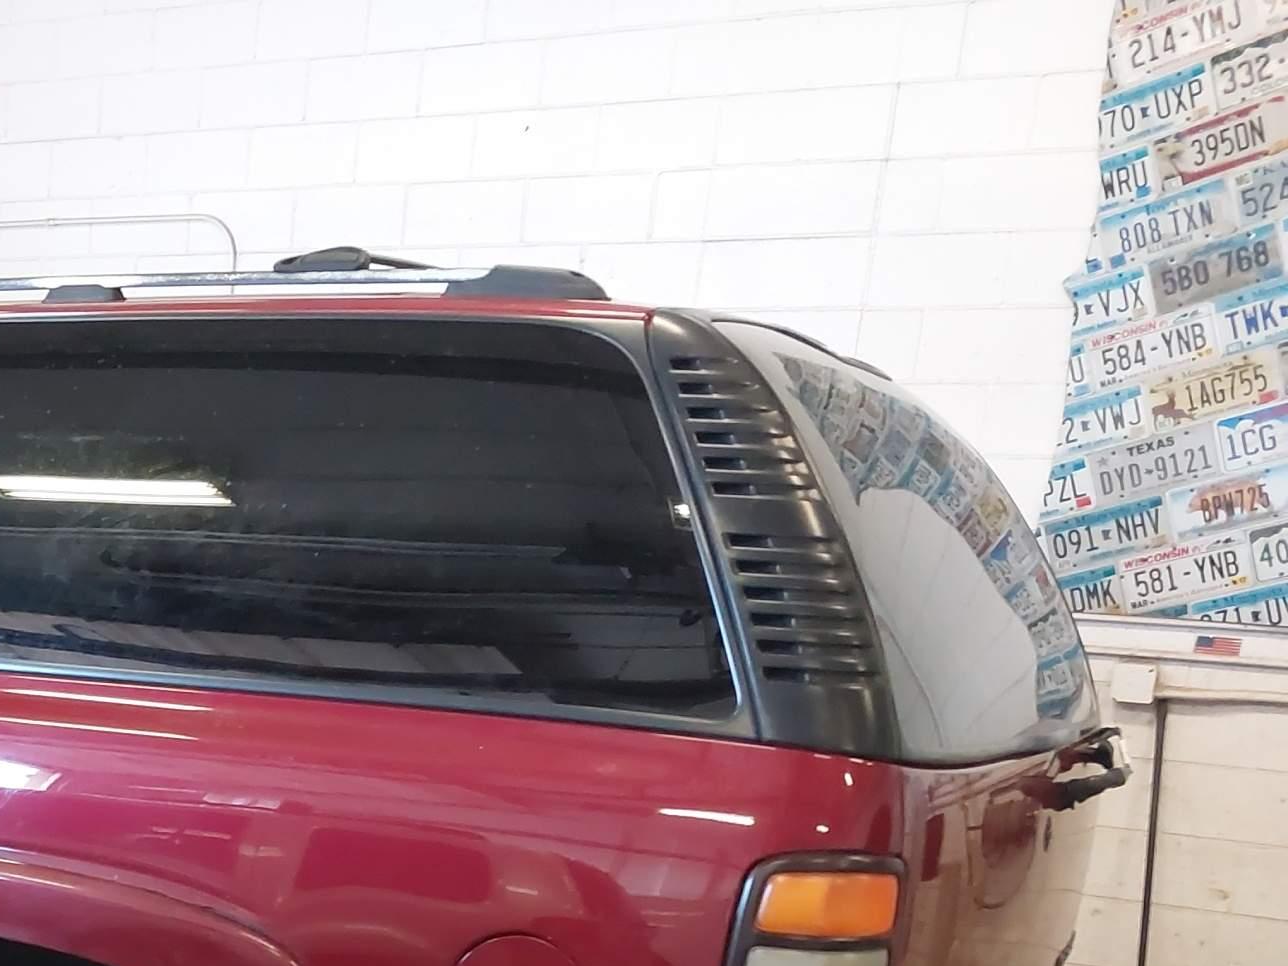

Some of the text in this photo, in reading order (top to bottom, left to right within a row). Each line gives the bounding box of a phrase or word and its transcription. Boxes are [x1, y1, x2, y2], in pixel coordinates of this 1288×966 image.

[1129, 0, 1241, 69] 214-YMJ
[1220, 53, 1273, 95] 332
[1098, 78, 1203, 138] 70 UXP
[1100, 161, 1148, 200] WRU
[1119, 217, 1162, 253] 808
[1168, 201, 1214, 237] TXN
[1218, 240, 1270, 278] 768
[1098, 280, 1146, 317] VJX
[1091, 319, 1157, 348] WISCONSIN
[1224, 300, 1279, 340] TWK
[1102, 322, 1207, 376] 584-YNB
[1057, 417, 1079, 448] 2
[1095, 398, 1142, 435] VWJ
[1126, 436, 1176, 457] TEXAS
[1154, 444, 1213, 482] 9121
[1053, 509, 1161, 560] 091 NHV
[1123, 547, 1190, 570] WISCONSIN
[1134, 550, 1240, 598] 581-YNB
[1070, 579, 1119, 614] DMK
